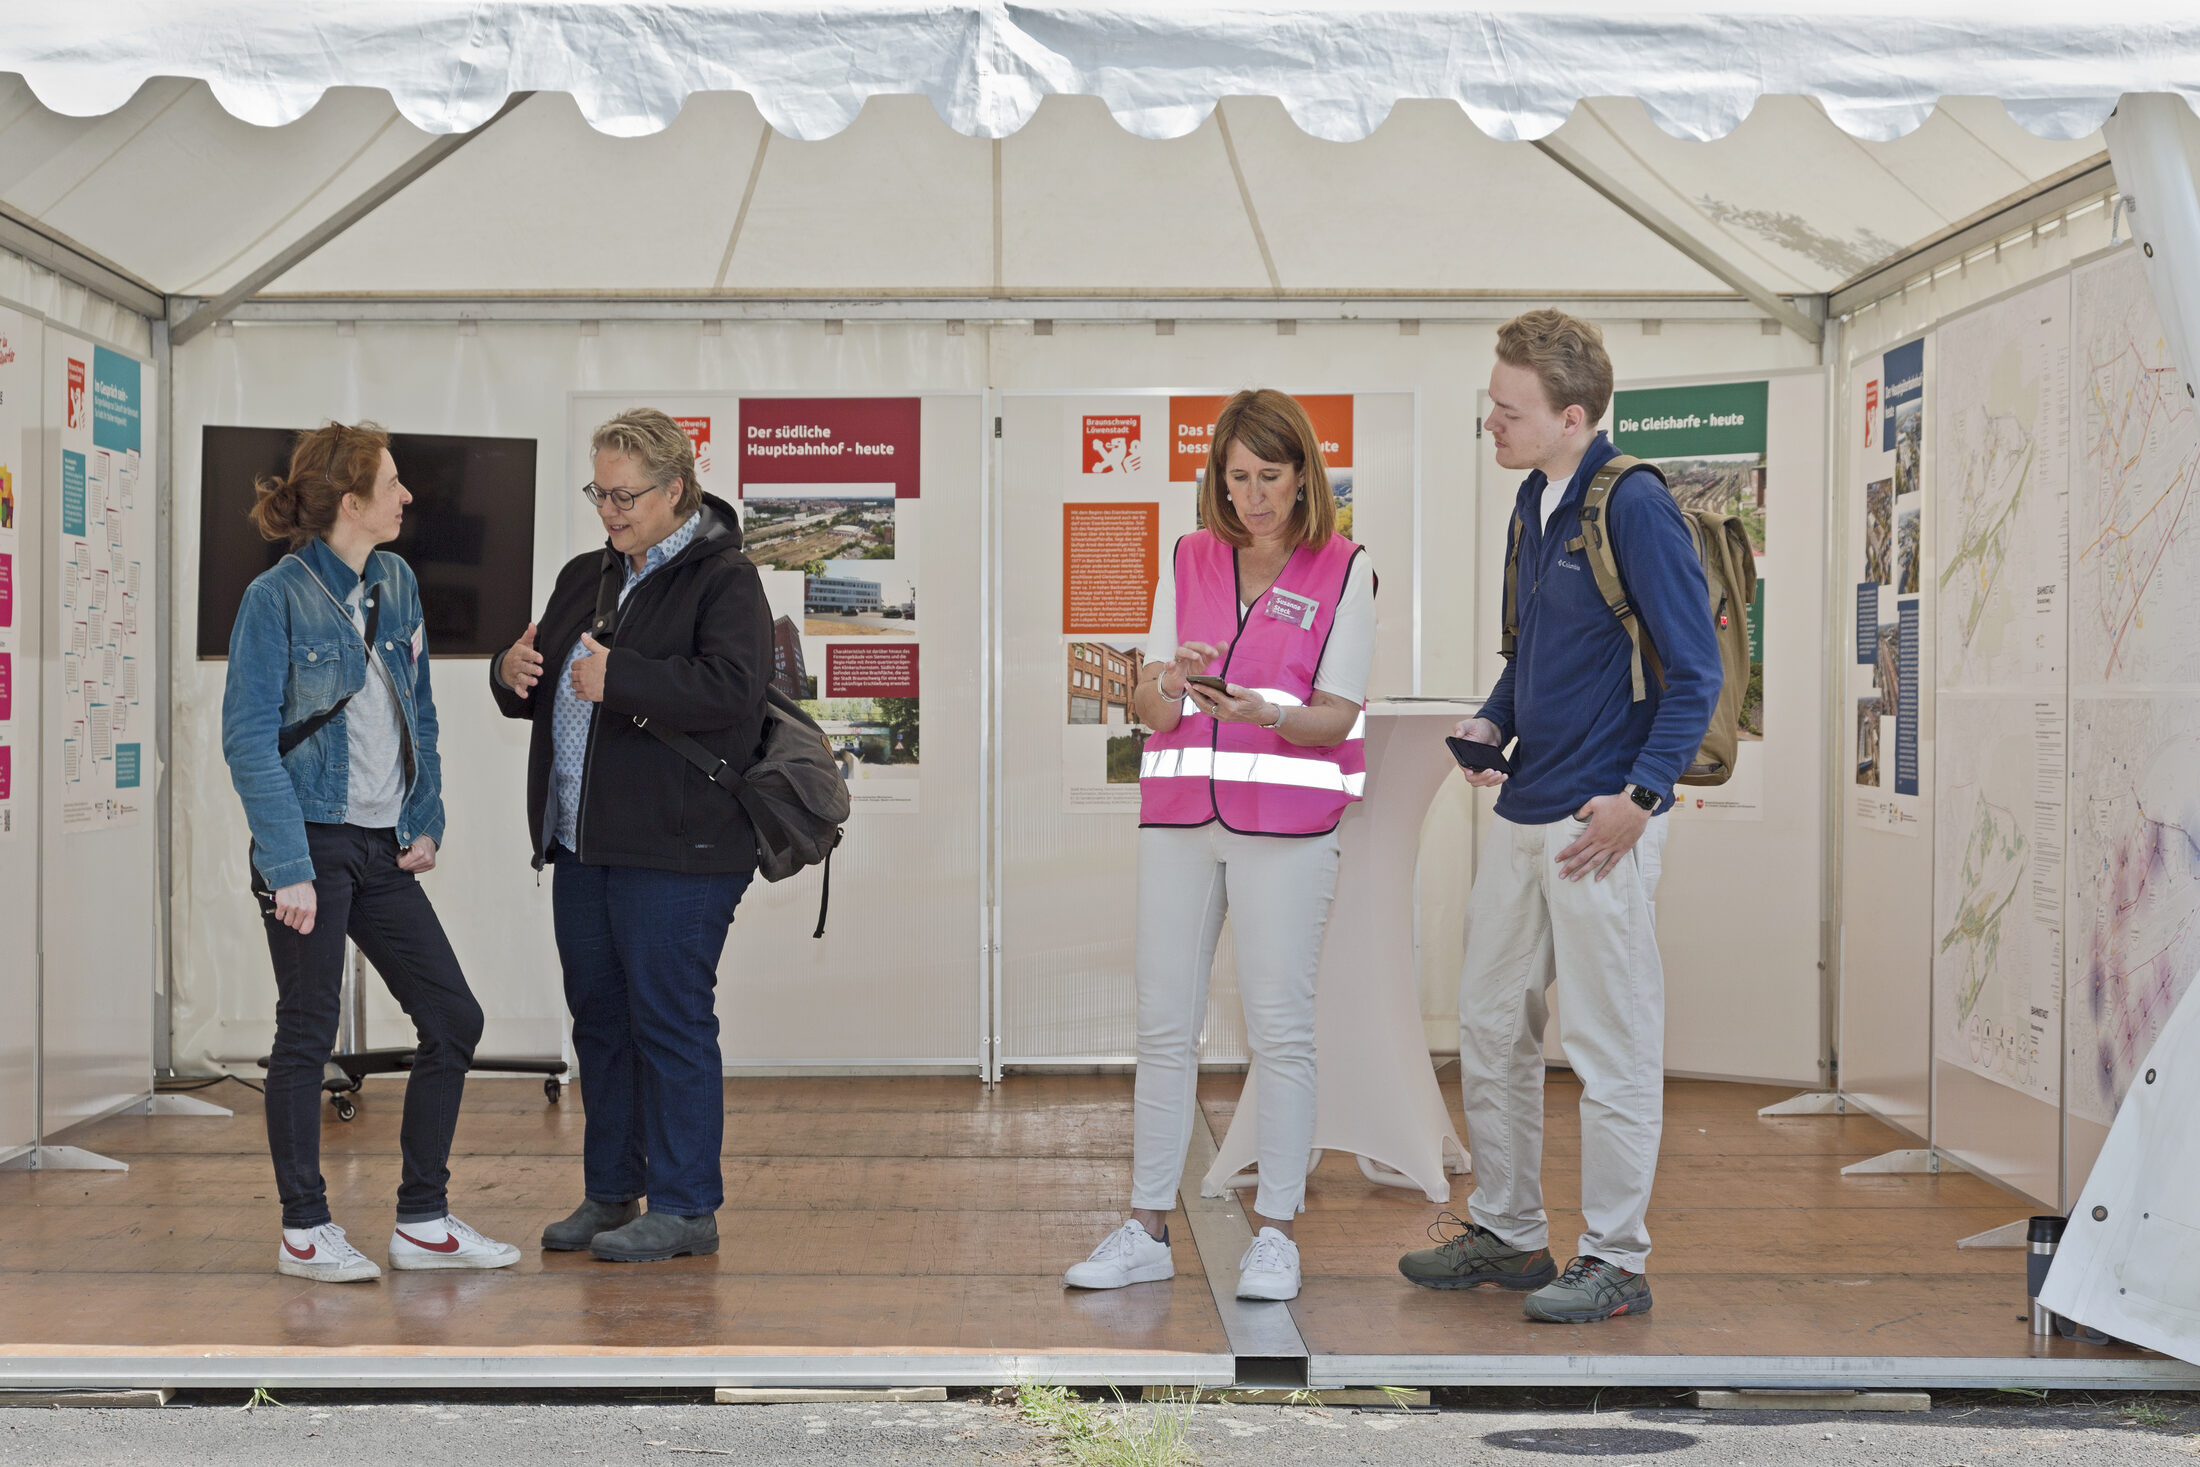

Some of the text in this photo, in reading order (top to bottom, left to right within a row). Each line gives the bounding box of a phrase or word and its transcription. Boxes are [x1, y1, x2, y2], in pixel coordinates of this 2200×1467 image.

[1086, 418, 1137, 426] Braunschweig
[1619, 419, 1638, 432] Die
[1641, 414, 1700, 431] Gleisharfe
[1710, 413, 1744, 427] heute
[747, 425, 831, 439] Der südliche
[1178, 424, 1203, 436] Das
[747, 442, 844, 458] Hauptbahnhof
[855, 442, 895, 455] heute
[1274, 605, 1292, 615] Steck
[1276, 598, 1302, 611] Susanne
